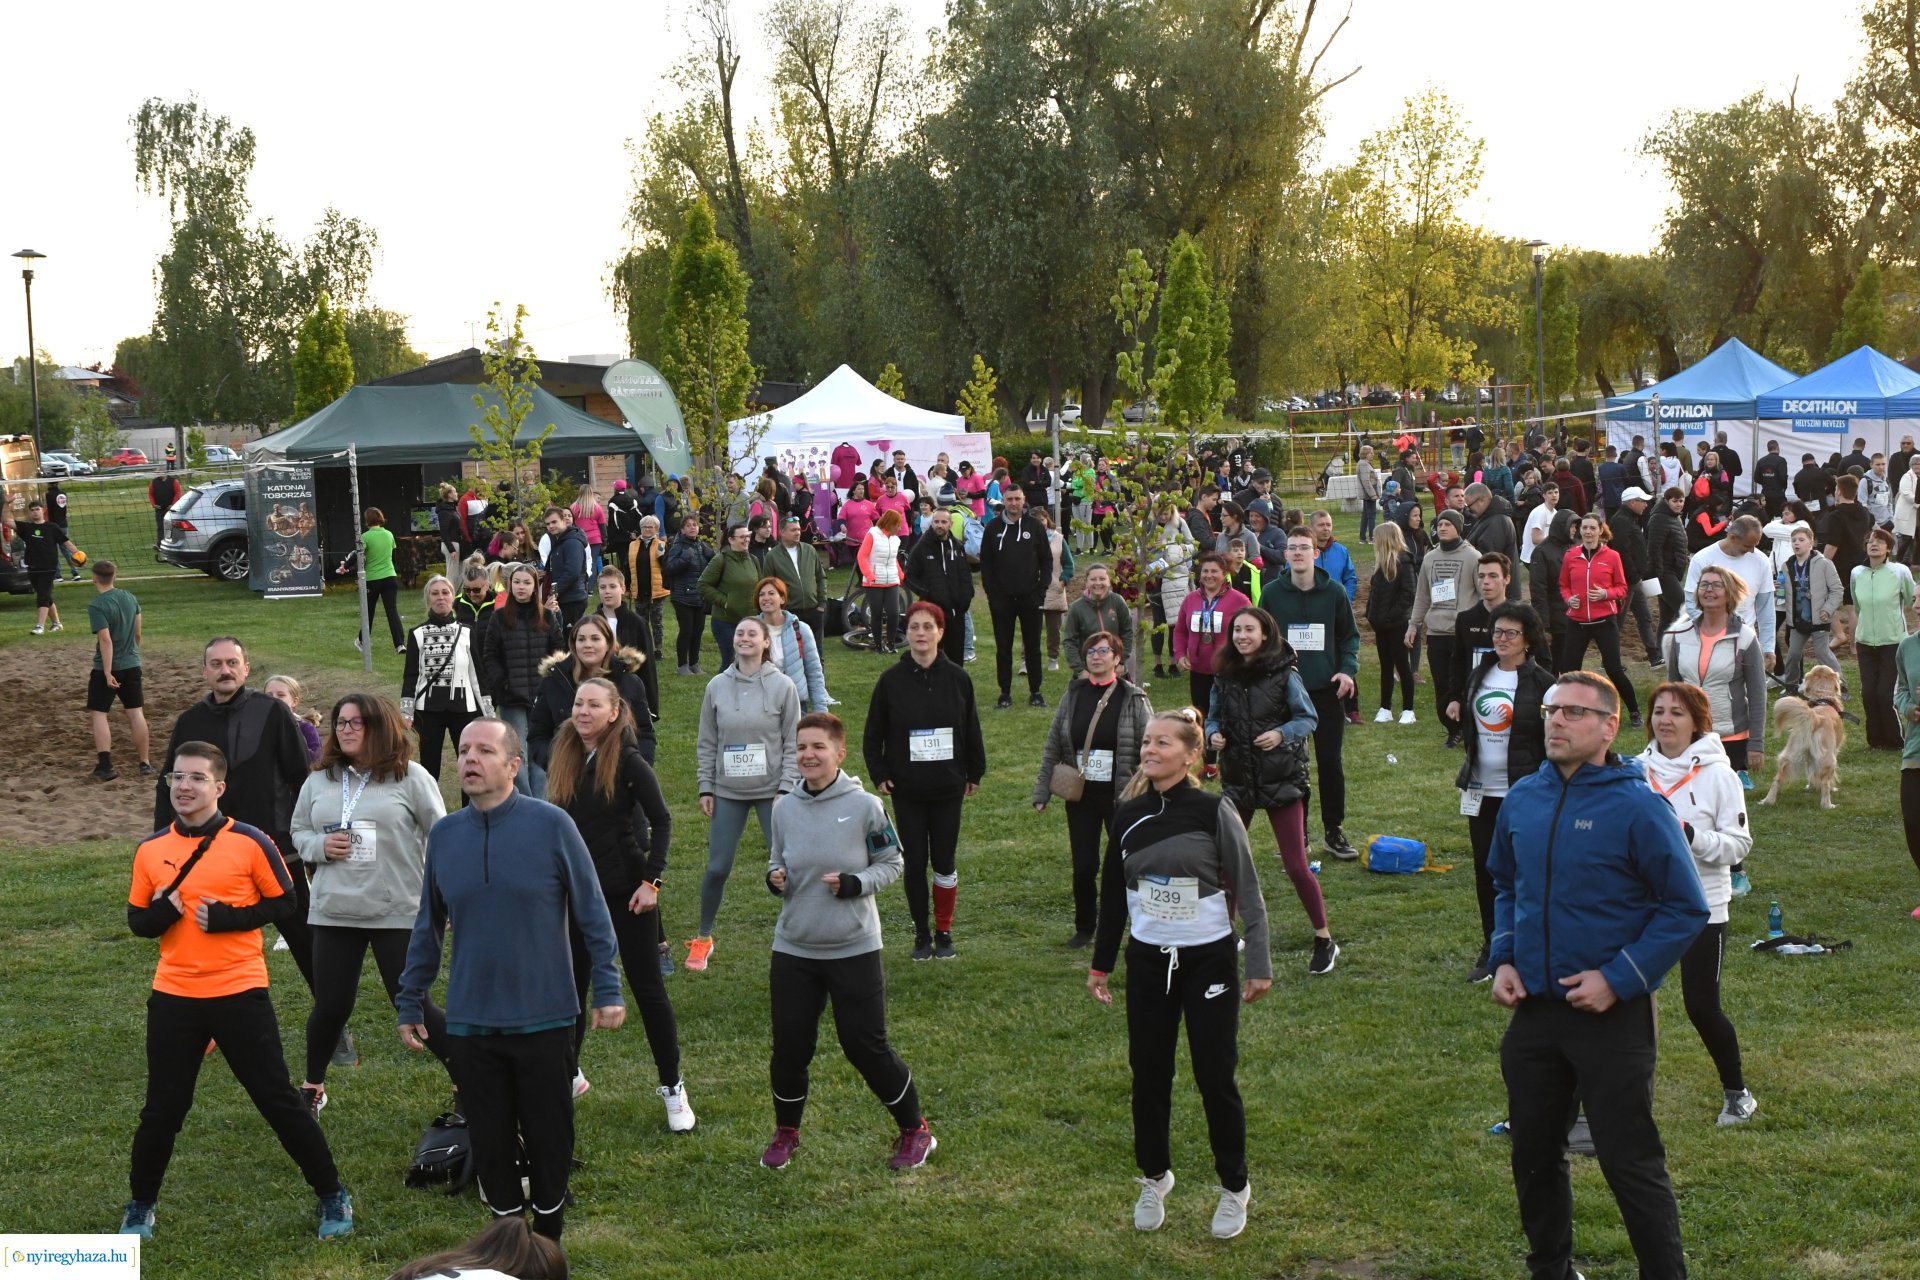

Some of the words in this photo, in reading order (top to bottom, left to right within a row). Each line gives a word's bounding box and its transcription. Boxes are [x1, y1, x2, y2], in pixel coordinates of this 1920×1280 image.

[1645, 404, 1713, 418] DCATHLON
[1782, 399, 1857, 415] DECATHLON
[267, 484, 306, 492] KATONAI
[261, 490, 312, 499] TOBORZÁS
[924, 738, 940, 748] 1311
[733, 753, 755, 764] 1507
[1574, 819, 1593, 830] HH
[1150, 886, 1181, 904] 1239
